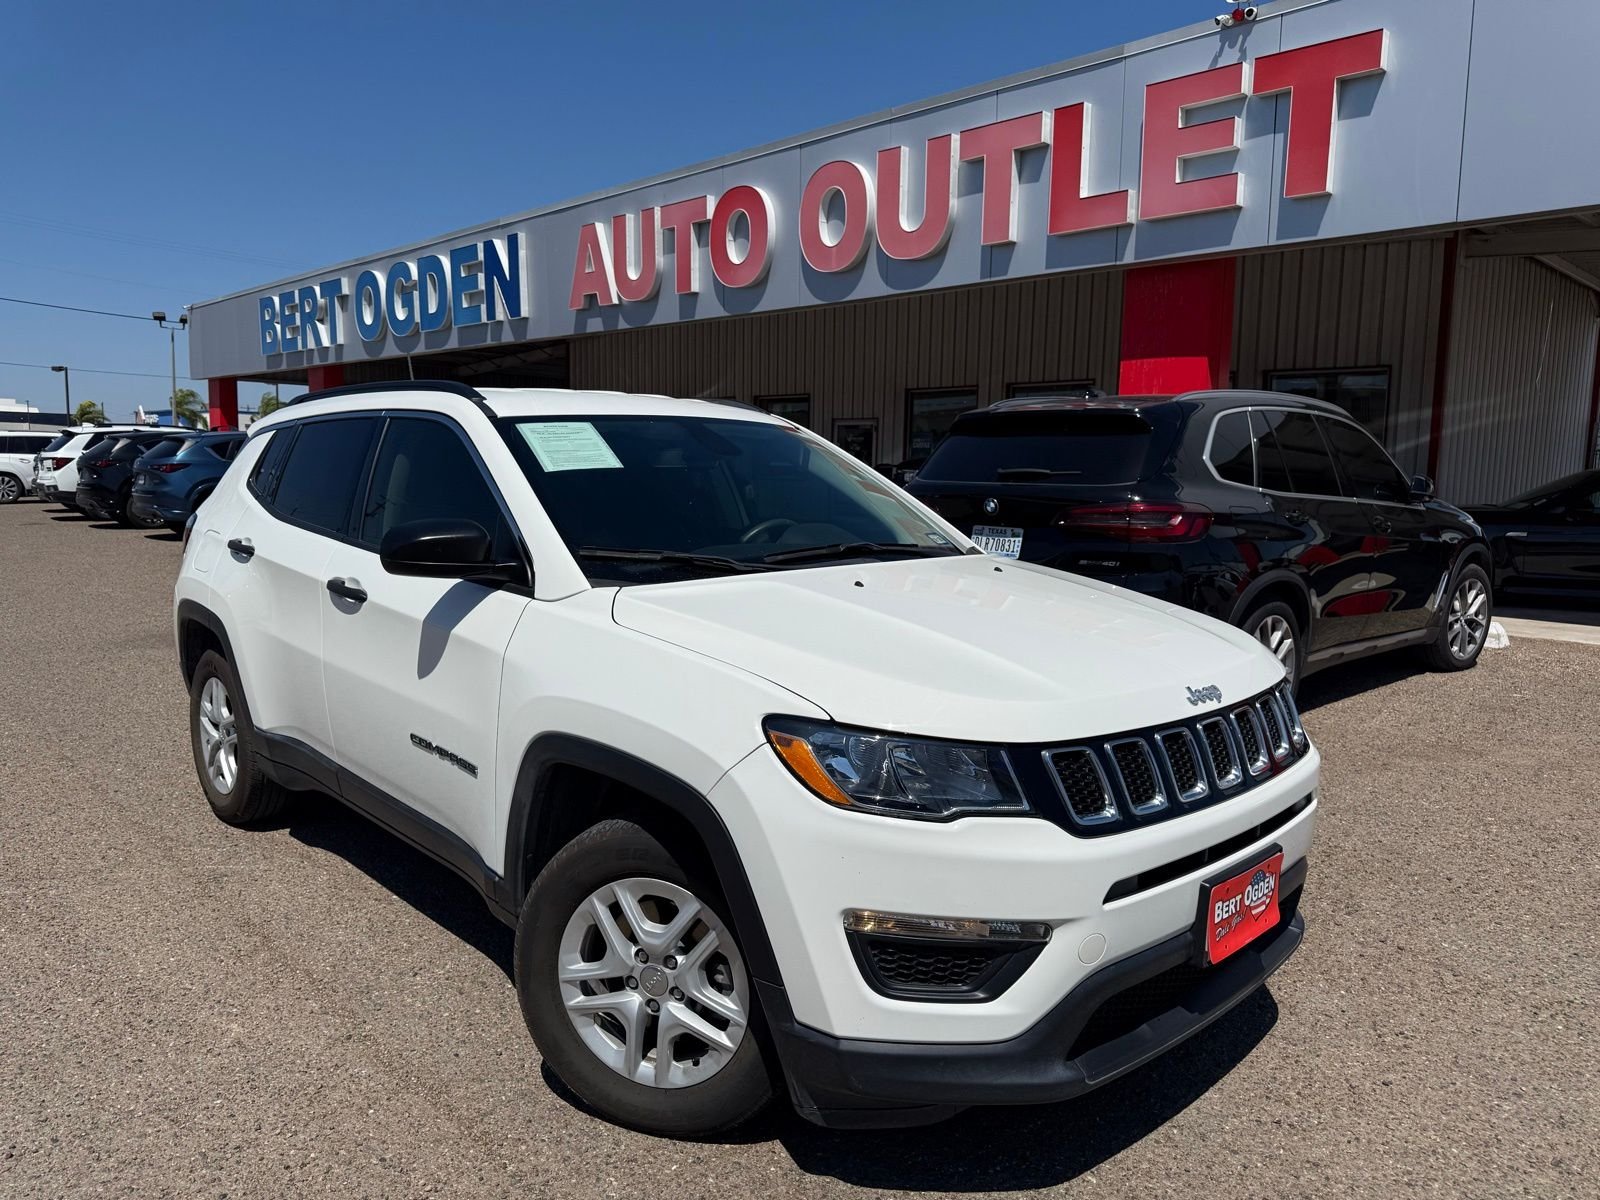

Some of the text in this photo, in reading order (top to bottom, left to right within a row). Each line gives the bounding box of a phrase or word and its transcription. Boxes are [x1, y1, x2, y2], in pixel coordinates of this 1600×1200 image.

[259, 28, 1389, 356] BERT OGDEN AUTO OUTLET
[988, 527, 1008, 535] TEXAS
[1185, 684, 1222, 706] Jeep
[410, 732, 478, 776] COMPASS
[1214, 874, 1275, 924] BERT OGDEN
